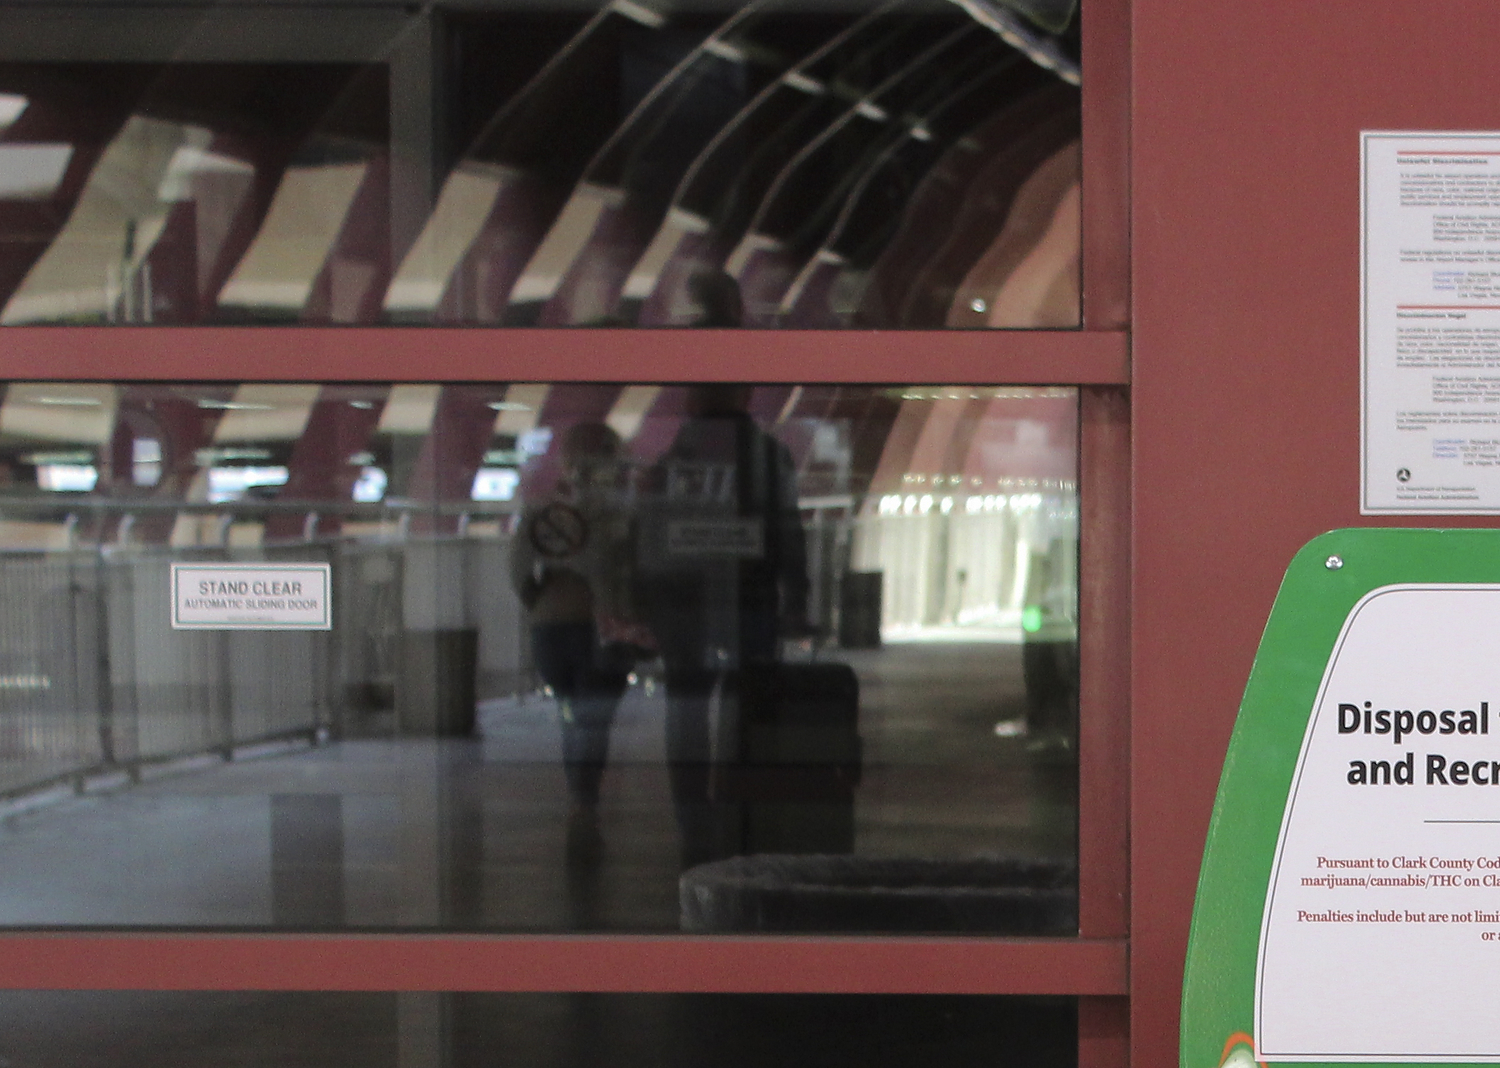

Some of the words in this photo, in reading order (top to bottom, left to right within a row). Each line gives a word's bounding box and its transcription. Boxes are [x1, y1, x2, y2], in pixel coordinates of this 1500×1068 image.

[199, 581, 249, 596] STAND
[252, 581, 302, 596] CLEAR
[185, 598, 243, 609] AUTOMATIC
[246, 599, 286, 609] SLIDING
[287, 599, 318, 610] DOOR
[1338, 701, 1489, 745] Disposal
[1346, 751, 1415, 786] and
[1316, 856, 1374, 869] Pursuant
[1376, 857, 1390, 869] to
[1391, 855, 1428, 869] Clark
[1429, 856, 1475, 872] County
[1300, 874, 1462, 890] marijuana/cannabis/THC
[1463, 877, 1480, 887] on
[1297, 909, 1354, 923] Penalties
[1355, 909, 1403, 923] include
[1404, 909, 1427, 923] but
[1428, 913, 1449, 923] are
[1451, 911, 1473, 923] not
[1481, 931, 1496, 942] or
